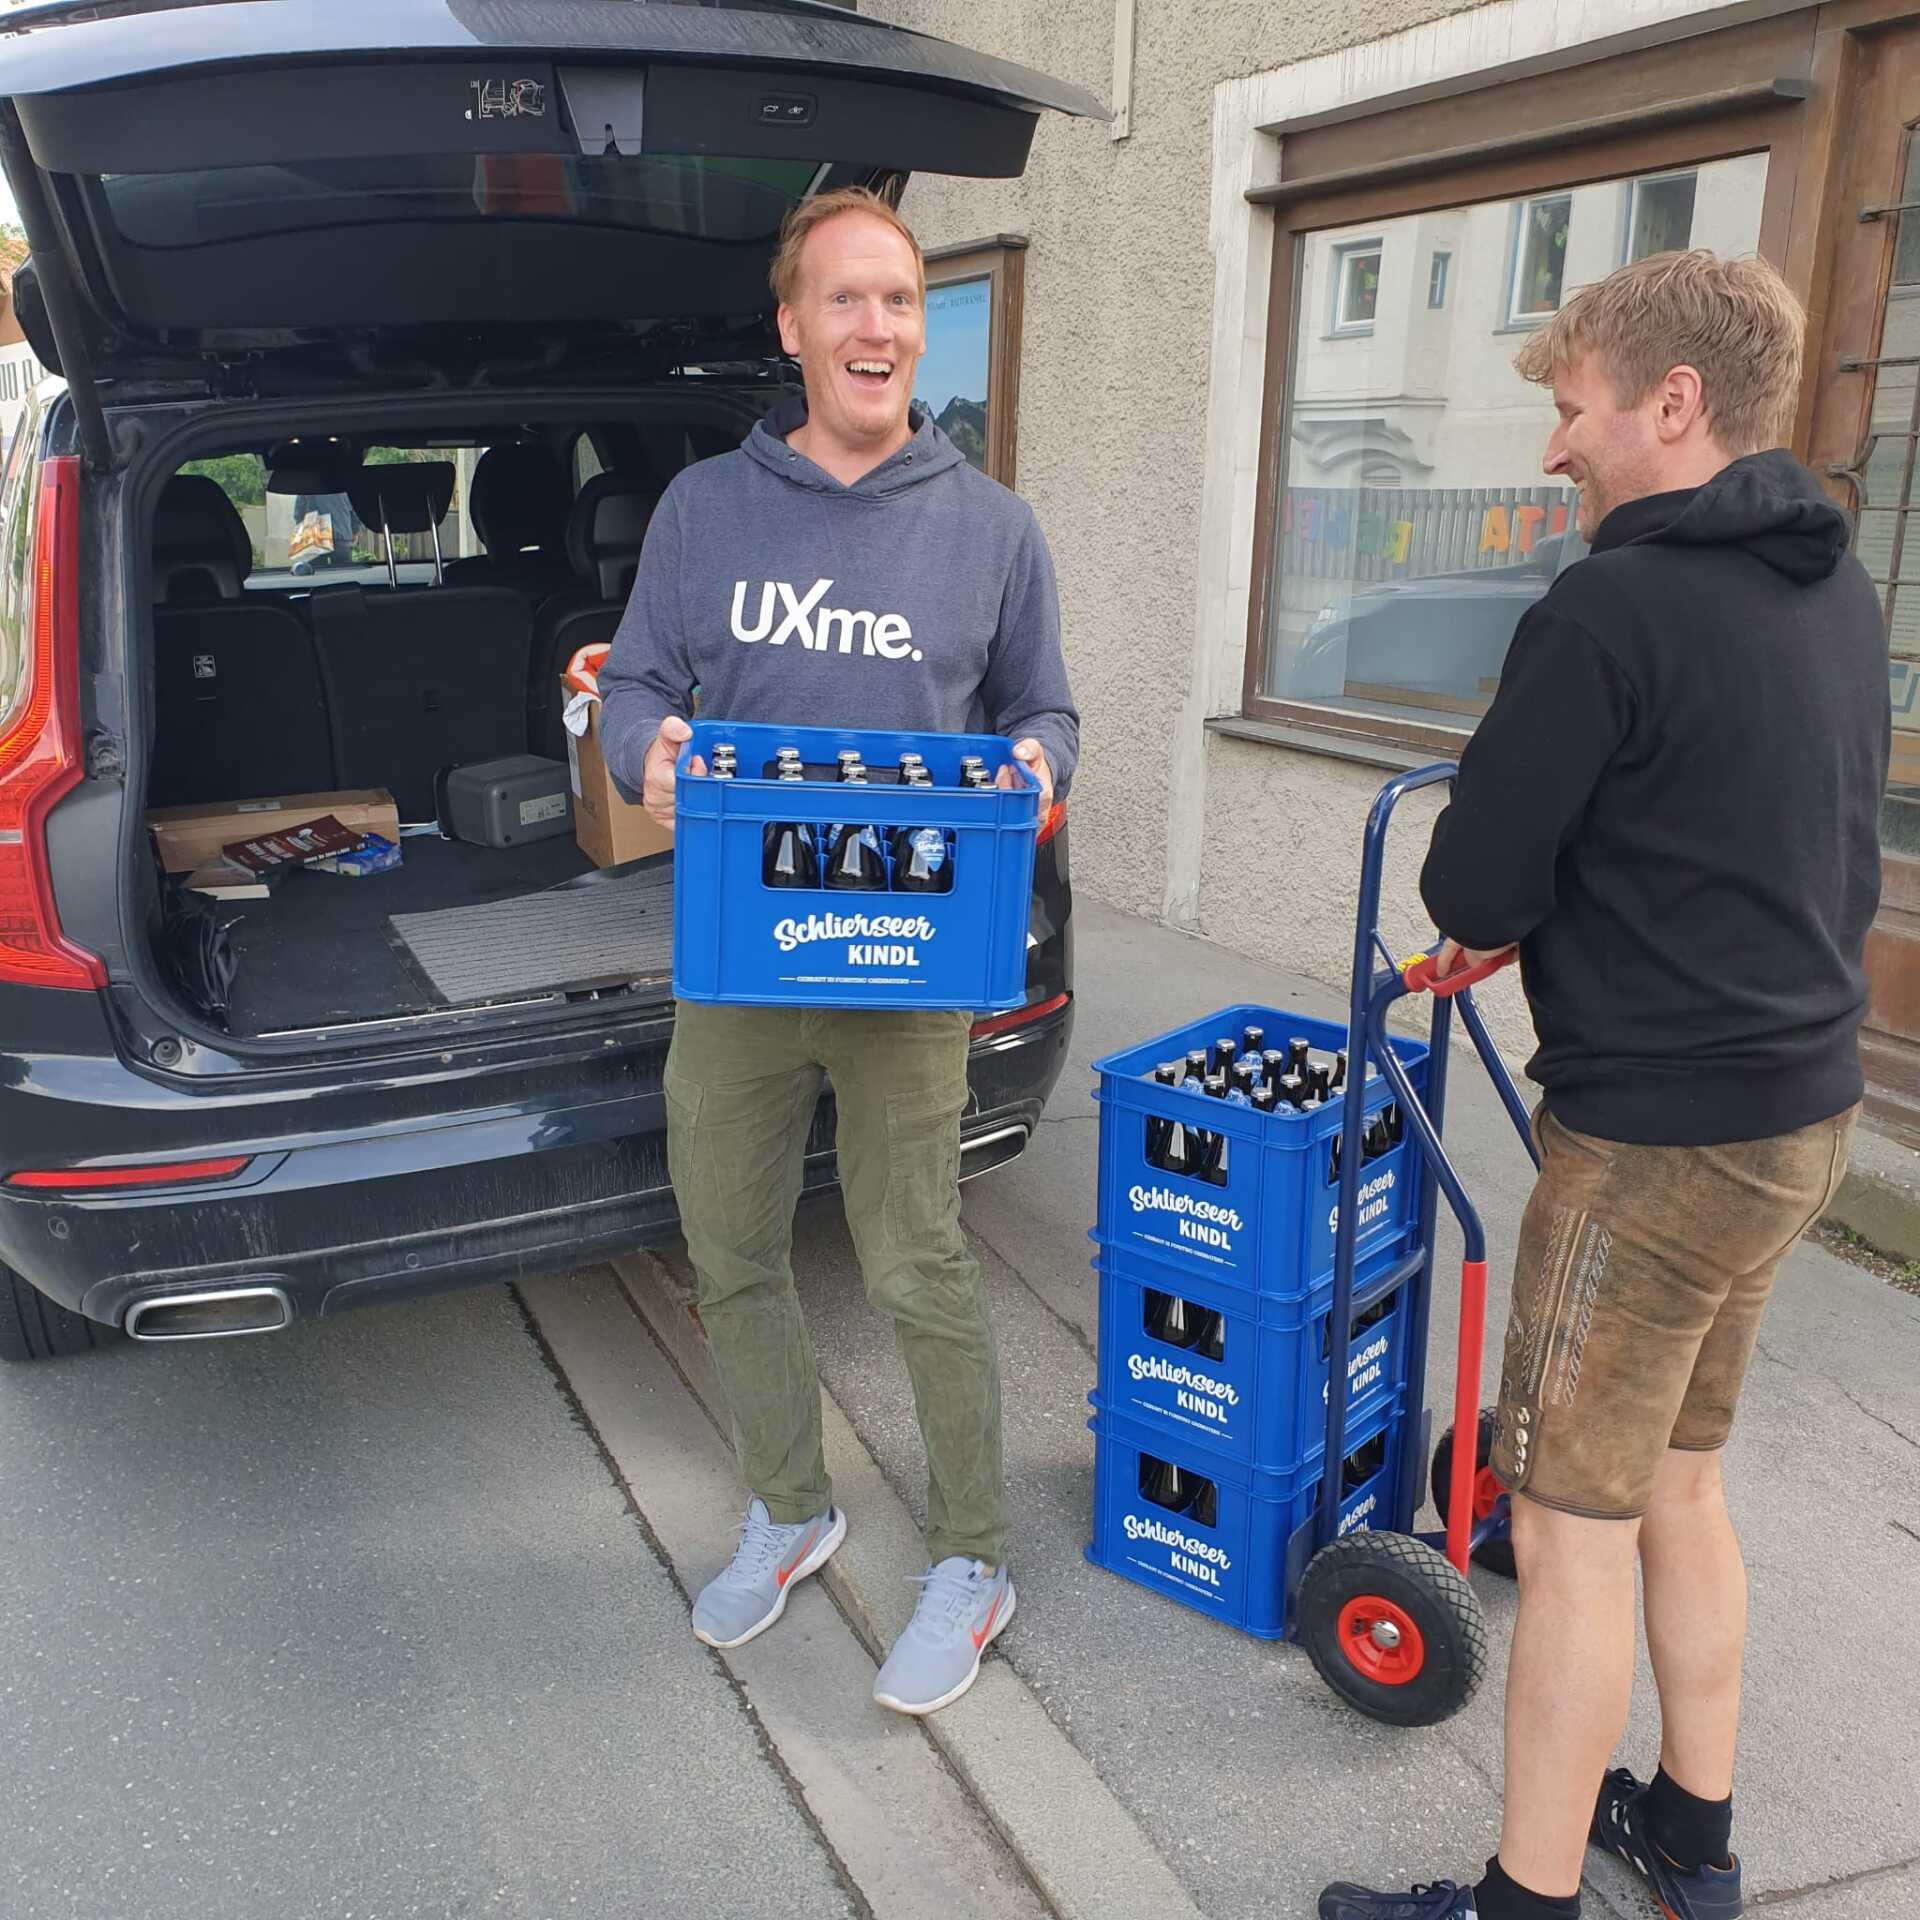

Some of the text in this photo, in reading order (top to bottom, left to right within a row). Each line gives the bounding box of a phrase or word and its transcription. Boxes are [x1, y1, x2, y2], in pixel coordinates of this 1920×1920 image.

[731, 578, 923, 662] UXme.
[774, 912, 936, 951] Schlierseer
[848, 944, 919, 966] KINDL
[1129, 1185, 1243, 1231] Schlierseer
[1358, 1195, 1388, 1226] KINDL
[1180, 1219, 1231, 1251] KINDL
[1127, 1354, 1239, 1405] Schlierseer
[1352, 1361, 1381, 1394] KINDL
[1177, 1389, 1227, 1424] KINDL
[1123, 1514, 1231, 1570] Schlierseer
[1171, 1551, 1220, 1586] KINDL
